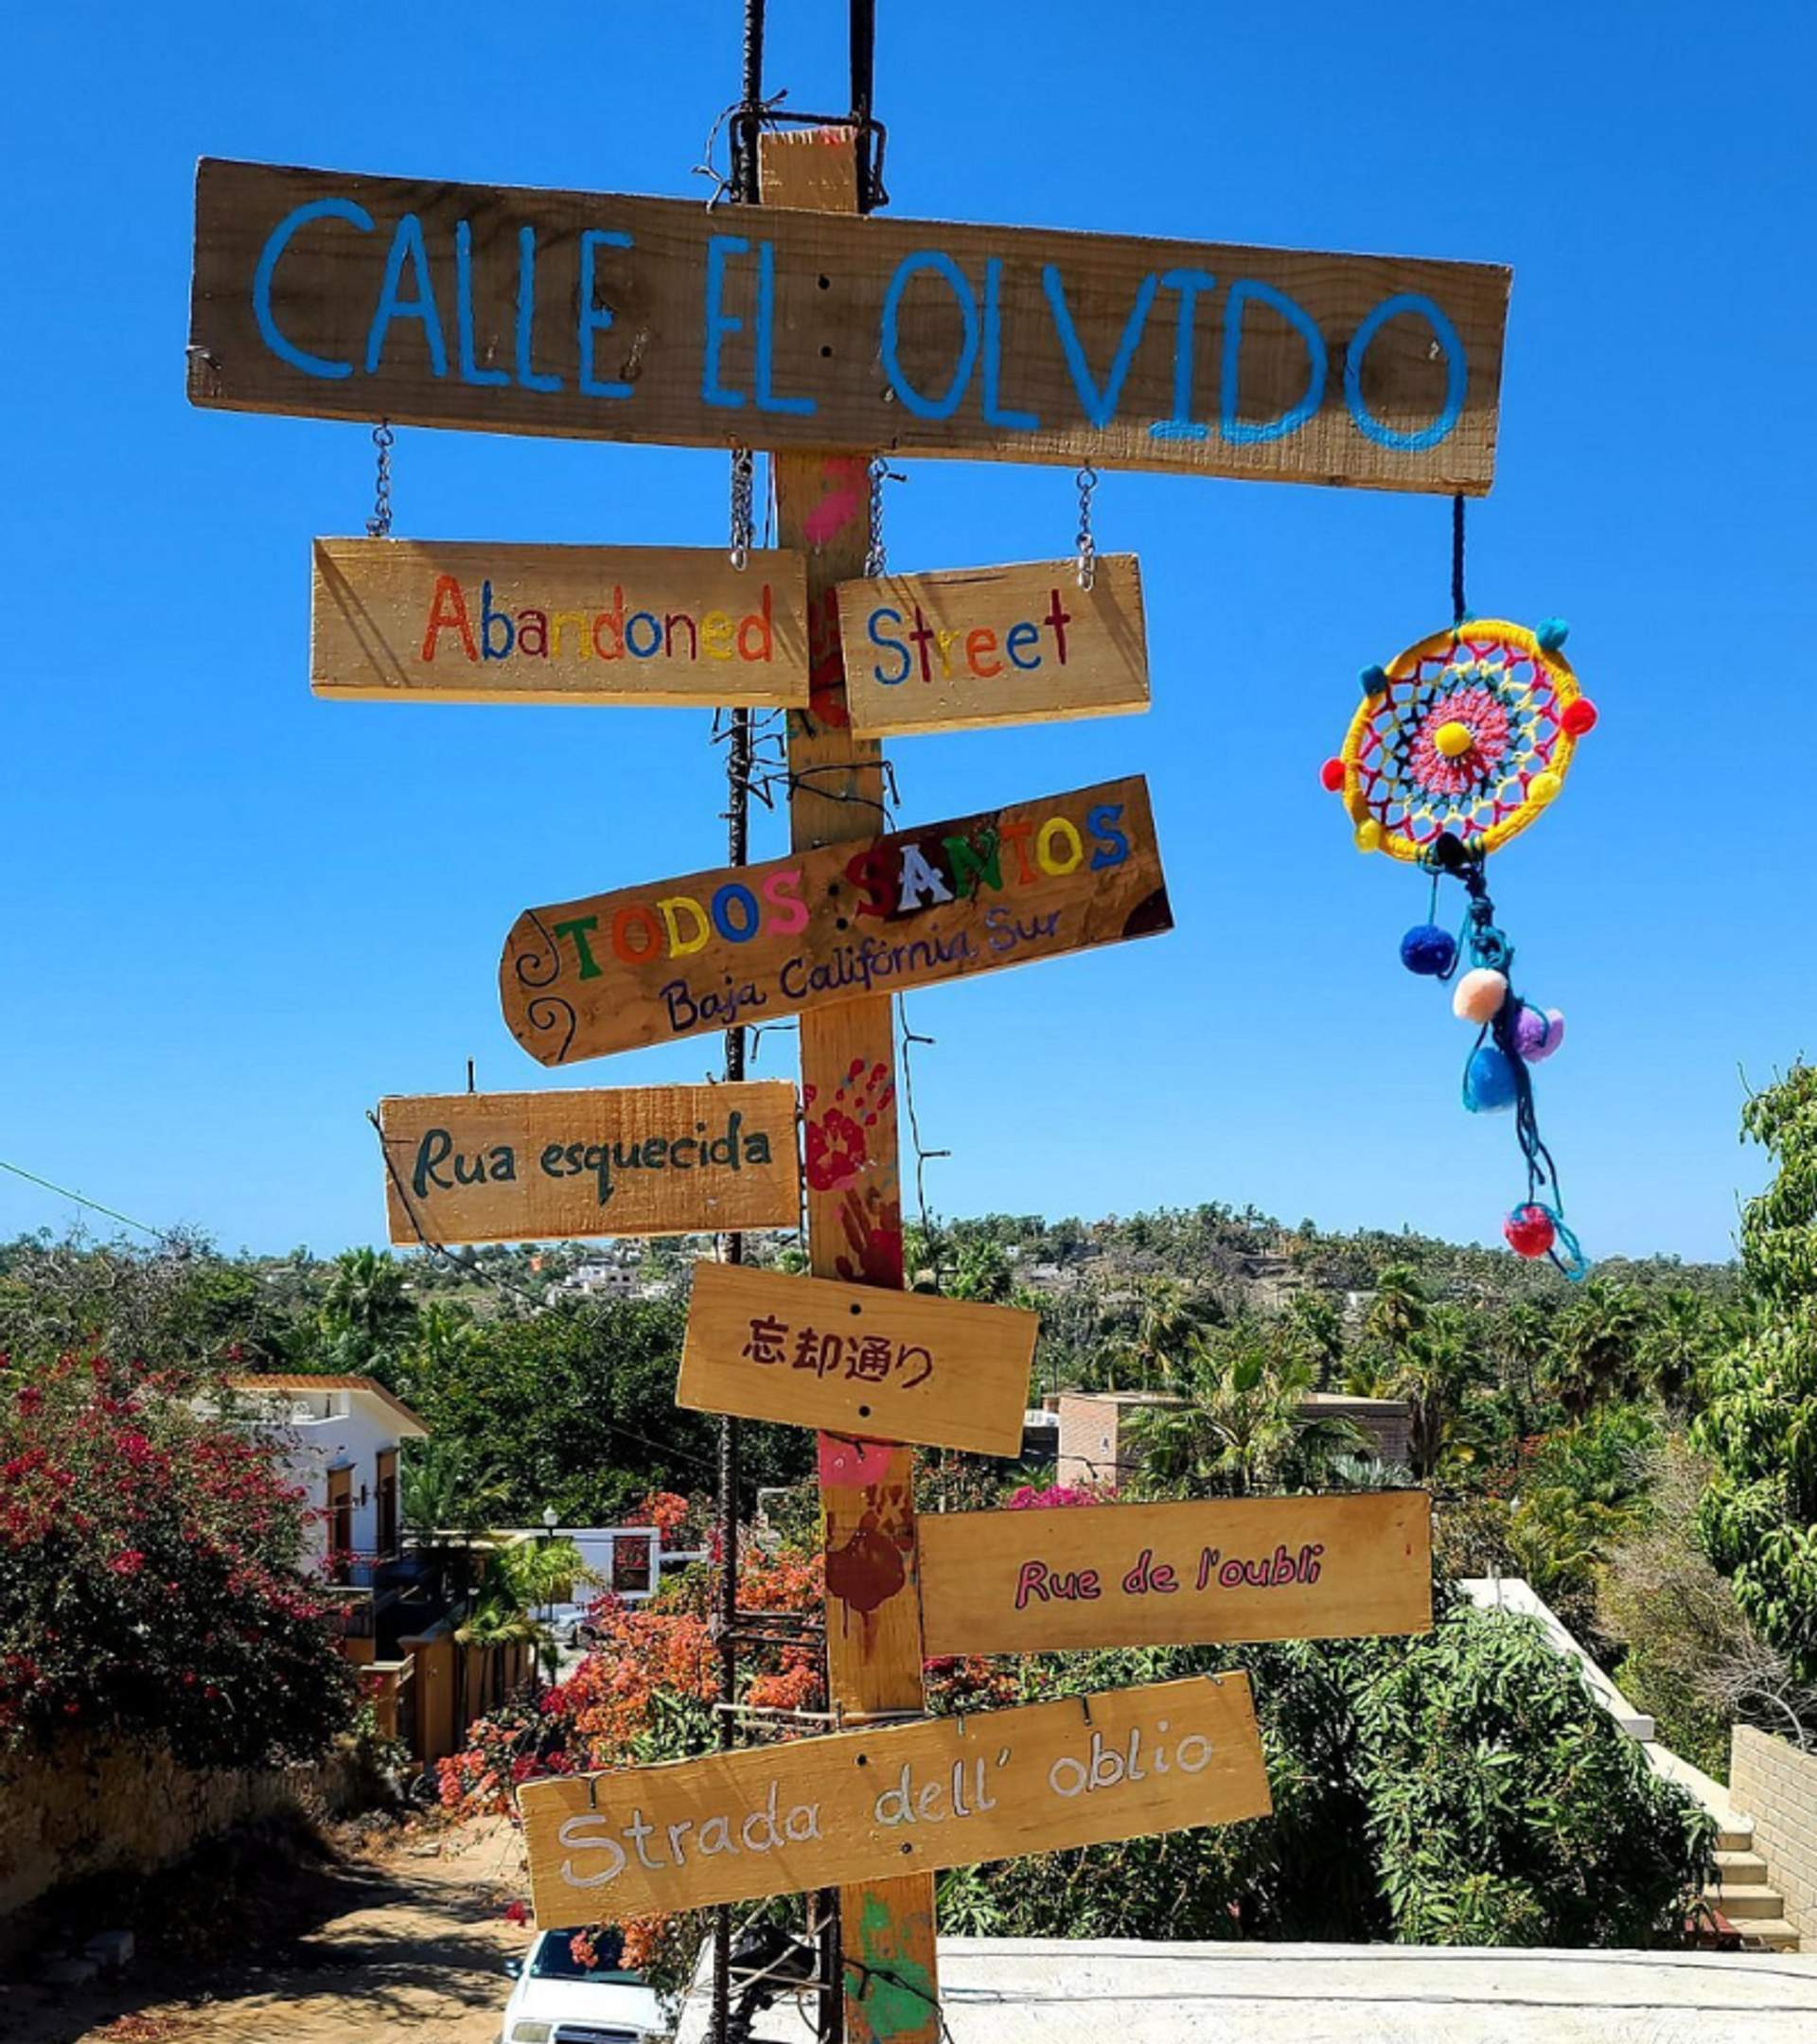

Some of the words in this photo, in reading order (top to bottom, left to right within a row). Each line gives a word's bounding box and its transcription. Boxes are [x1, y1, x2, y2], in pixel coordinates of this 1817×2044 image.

[252, 197, 635, 398] CALLE
[701, 235, 820, 414] EL
[880, 250, 1469, 452] OLVIDO
[420, 574, 773, 662] Abandoned
[866, 587, 1071, 685] Street
[555, 869, 809, 980] TODOS
[845, 803, 1131, 921] SANTOS
[658, 978, 768, 1032] Baja
[779, 923, 979, 998] California
[982, 907, 1063, 954] Sur
[412, 1128, 518, 1200] Rua
[539, 1110, 773, 1207] esquecida
[742, 1314, 933, 1389] 忘却通り
[1014, 1559, 1103, 1610] Rue
[1121, 1549, 1179, 1594] de
[1195, 1543, 1325, 1592] l'oubli
[557, 1780, 821, 1890] Strada
[873, 1747, 1013, 1828] dell'
[1048, 1720, 1215, 1799] oblio
